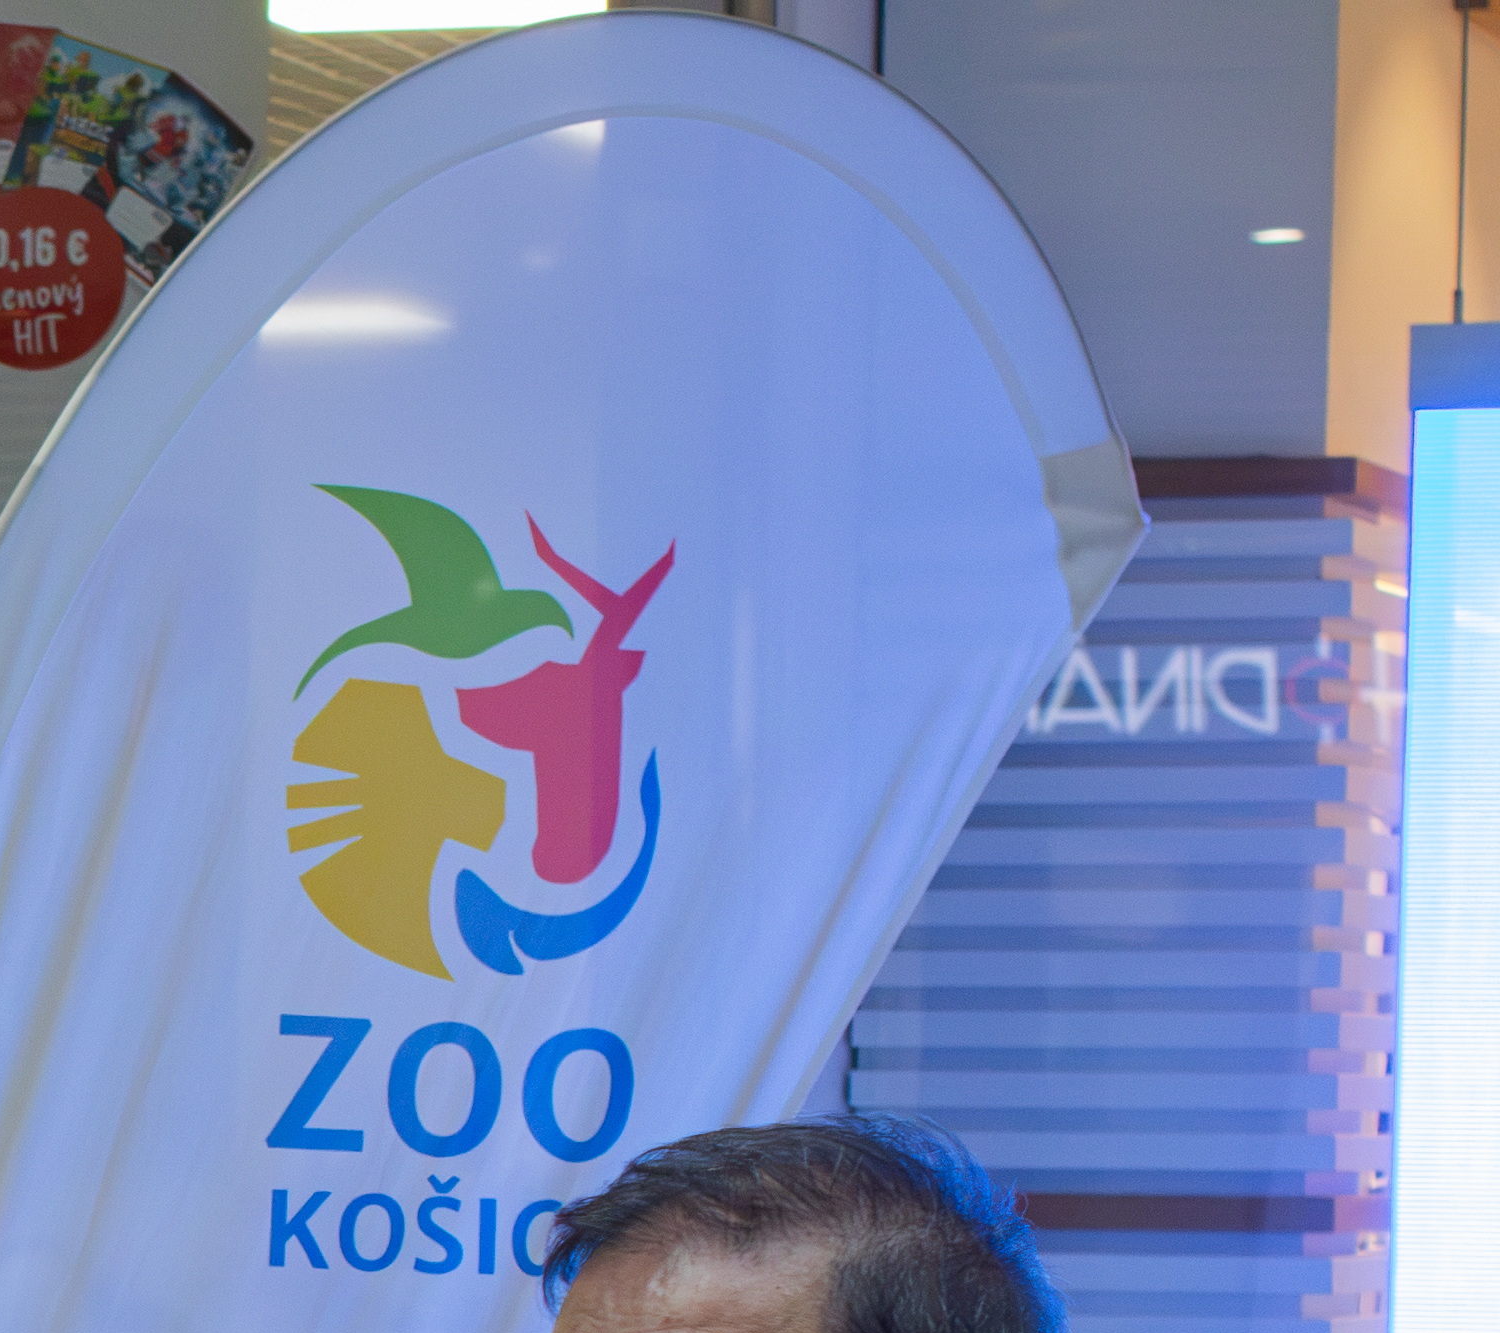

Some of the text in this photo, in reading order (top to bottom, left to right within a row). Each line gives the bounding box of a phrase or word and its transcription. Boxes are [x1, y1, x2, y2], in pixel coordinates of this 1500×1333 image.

[66, 229, 90, 266] €
[13, 313, 67, 355] HIT
[265, 1013, 635, 1163] ZOO
